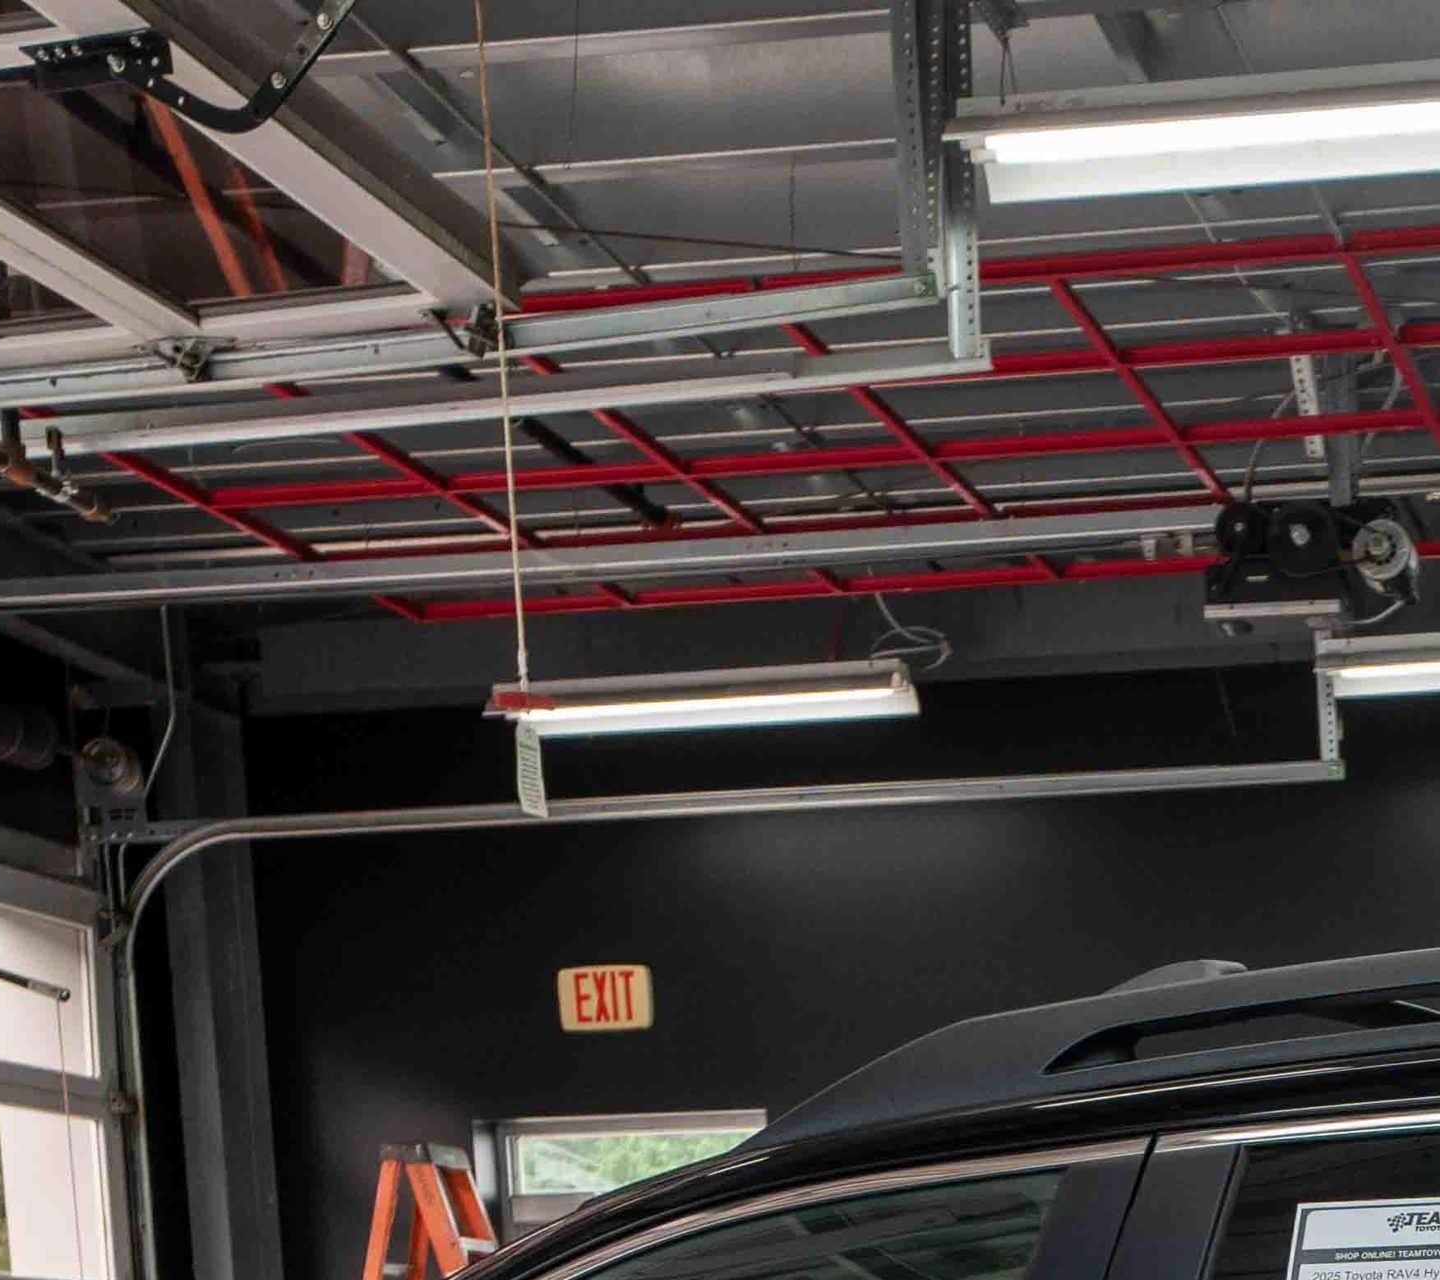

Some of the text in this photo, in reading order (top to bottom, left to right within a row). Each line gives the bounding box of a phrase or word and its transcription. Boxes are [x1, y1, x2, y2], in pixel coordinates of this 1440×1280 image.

[573, 970, 634, 1023] EXIT
[1334, 1251, 1360, 1261] SHOP
[1361, 1249, 1397, 1260] ONLINE!
[1386, 1269, 1420, 1280] RAV4
